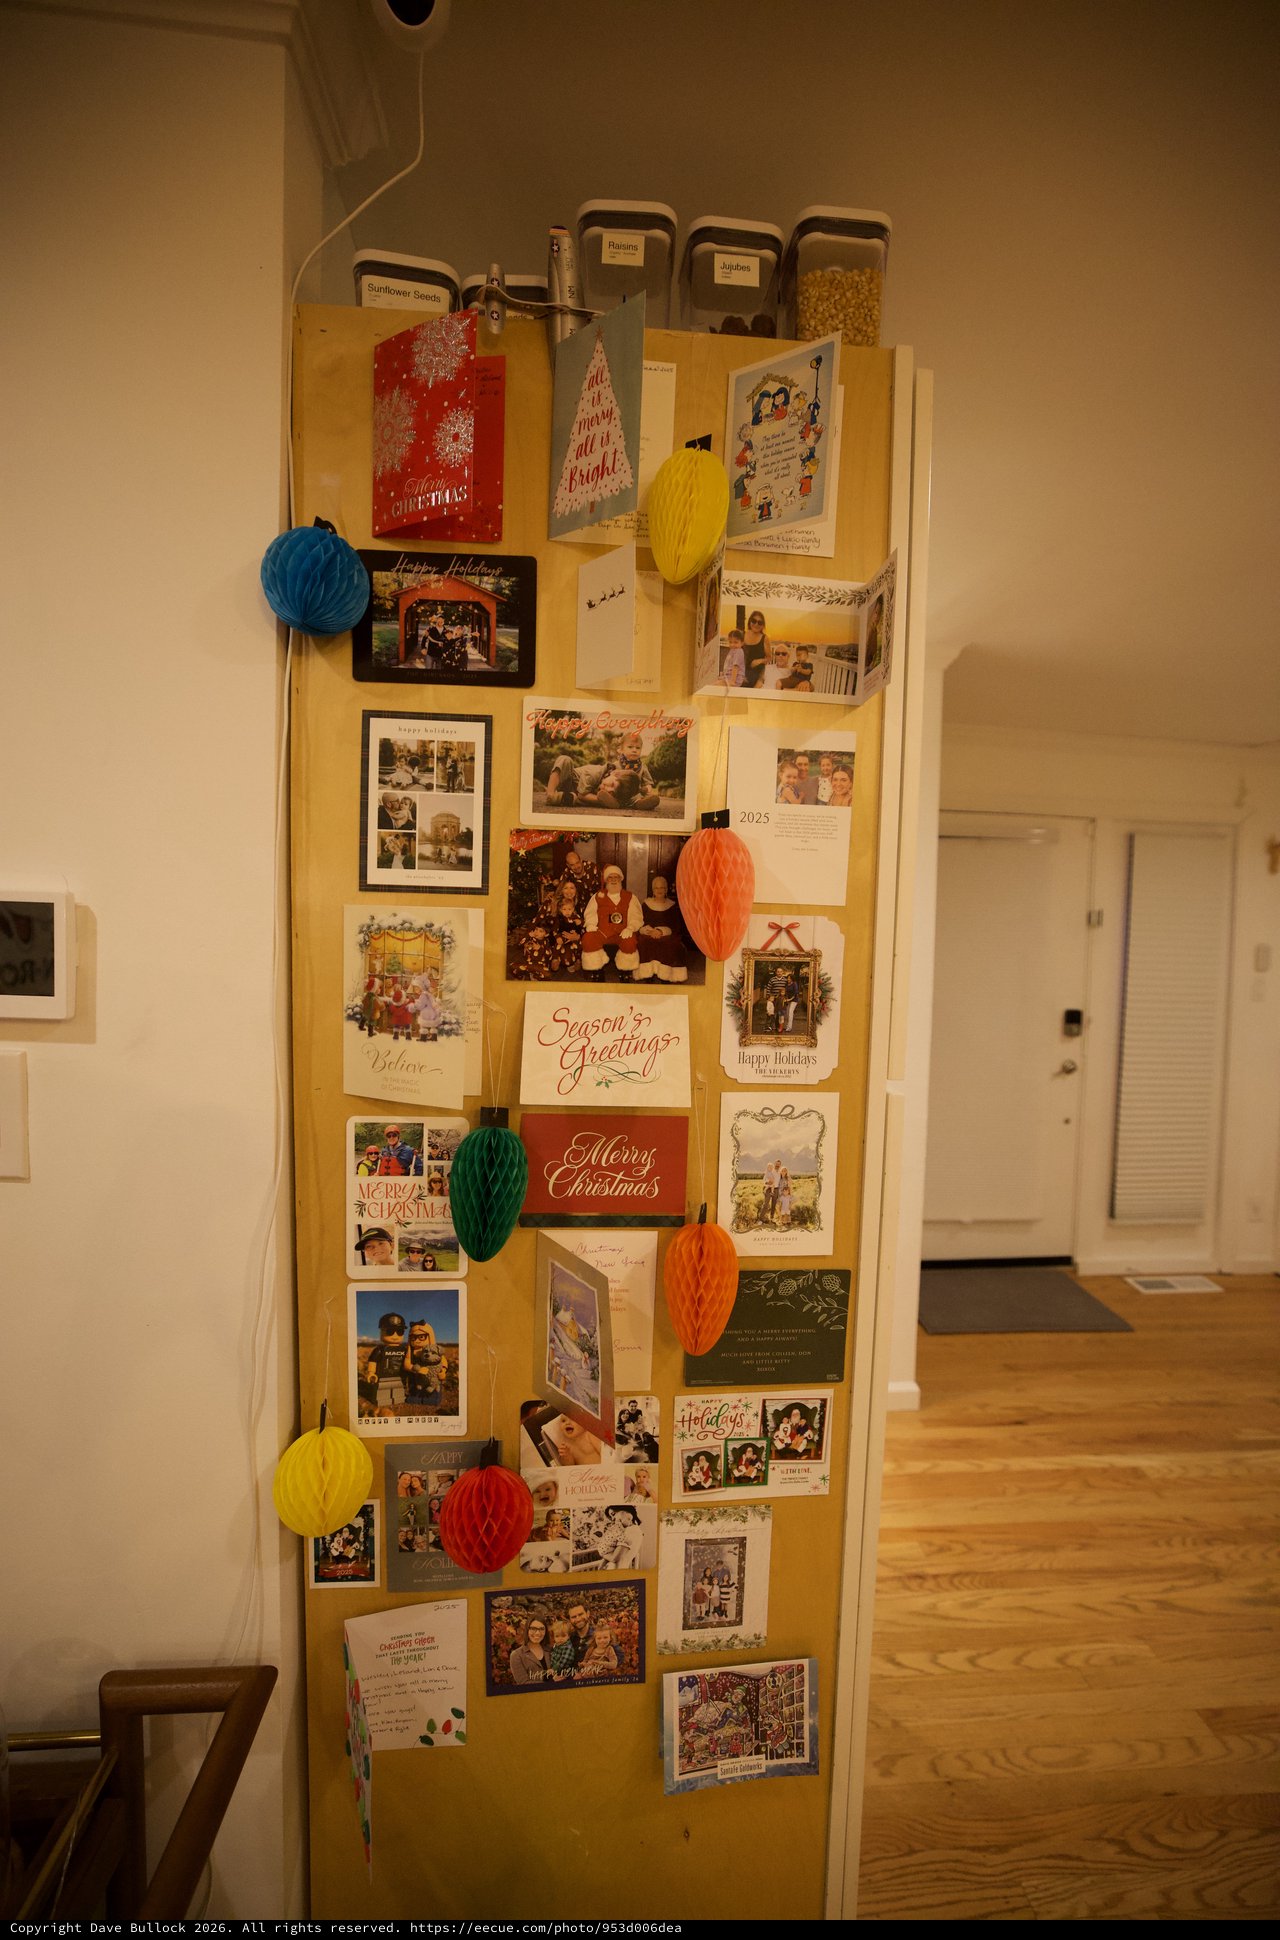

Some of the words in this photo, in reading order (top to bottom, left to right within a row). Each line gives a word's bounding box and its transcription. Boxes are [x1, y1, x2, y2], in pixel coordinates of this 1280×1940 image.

[608, 240, 639, 251] Raisins
[720, 261, 751, 273] Jujubes
[367, 283, 411, 298] Sunflower
[413, 291, 441, 303] Seeds
[588, 366, 606, 391] all
[591, 391, 603, 408] is
[578, 406, 615, 436] merry
[575, 434, 597, 461] all
[600, 429, 611, 448] is
[569, 447, 619, 493] Bright
[403, 473, 457, 499] Merry
[391, 485, 468, 518] CHRISTMAS
[391, 553, 439, 578] Happy
[444, 555, 503, 578] Holidays
[398, 726, 421, 734] happy
[424, 727, 458, 735] holidays
[526, 709, 592, 740] Happy
[593, 709, 697, 739] Everything
[739, 811, 770, 824] 2025
[537, 1005, 652, 1047] Season's
[361, 1042, 443, 1076] Believe
[557, 1032, 680, 1096] Greetings
[738, 1051, 771, 1069] Happy
[774, 1051, 817, 1070] Holidays
[563, 1131, 657, 1177] Merry
[543, 1160, 661, 1199] Christmas
[358, 1181, 417, 1202] MERRY
[676, 1403, 746, 1440] Holidays
[421, 1451, 464, 1465] HAPPY
[565, 1484, 617, 1495] HOLIDAYS
[412, 1556, 454, 1569] HOLI
[380, 1639, 413, 1652] CHRISTMAS
[415, 1636, 436, 1646] CHEER
[407, 1645, 439, 1653] THROUGHOUT
[391, 1656, 402, 1666] THE
